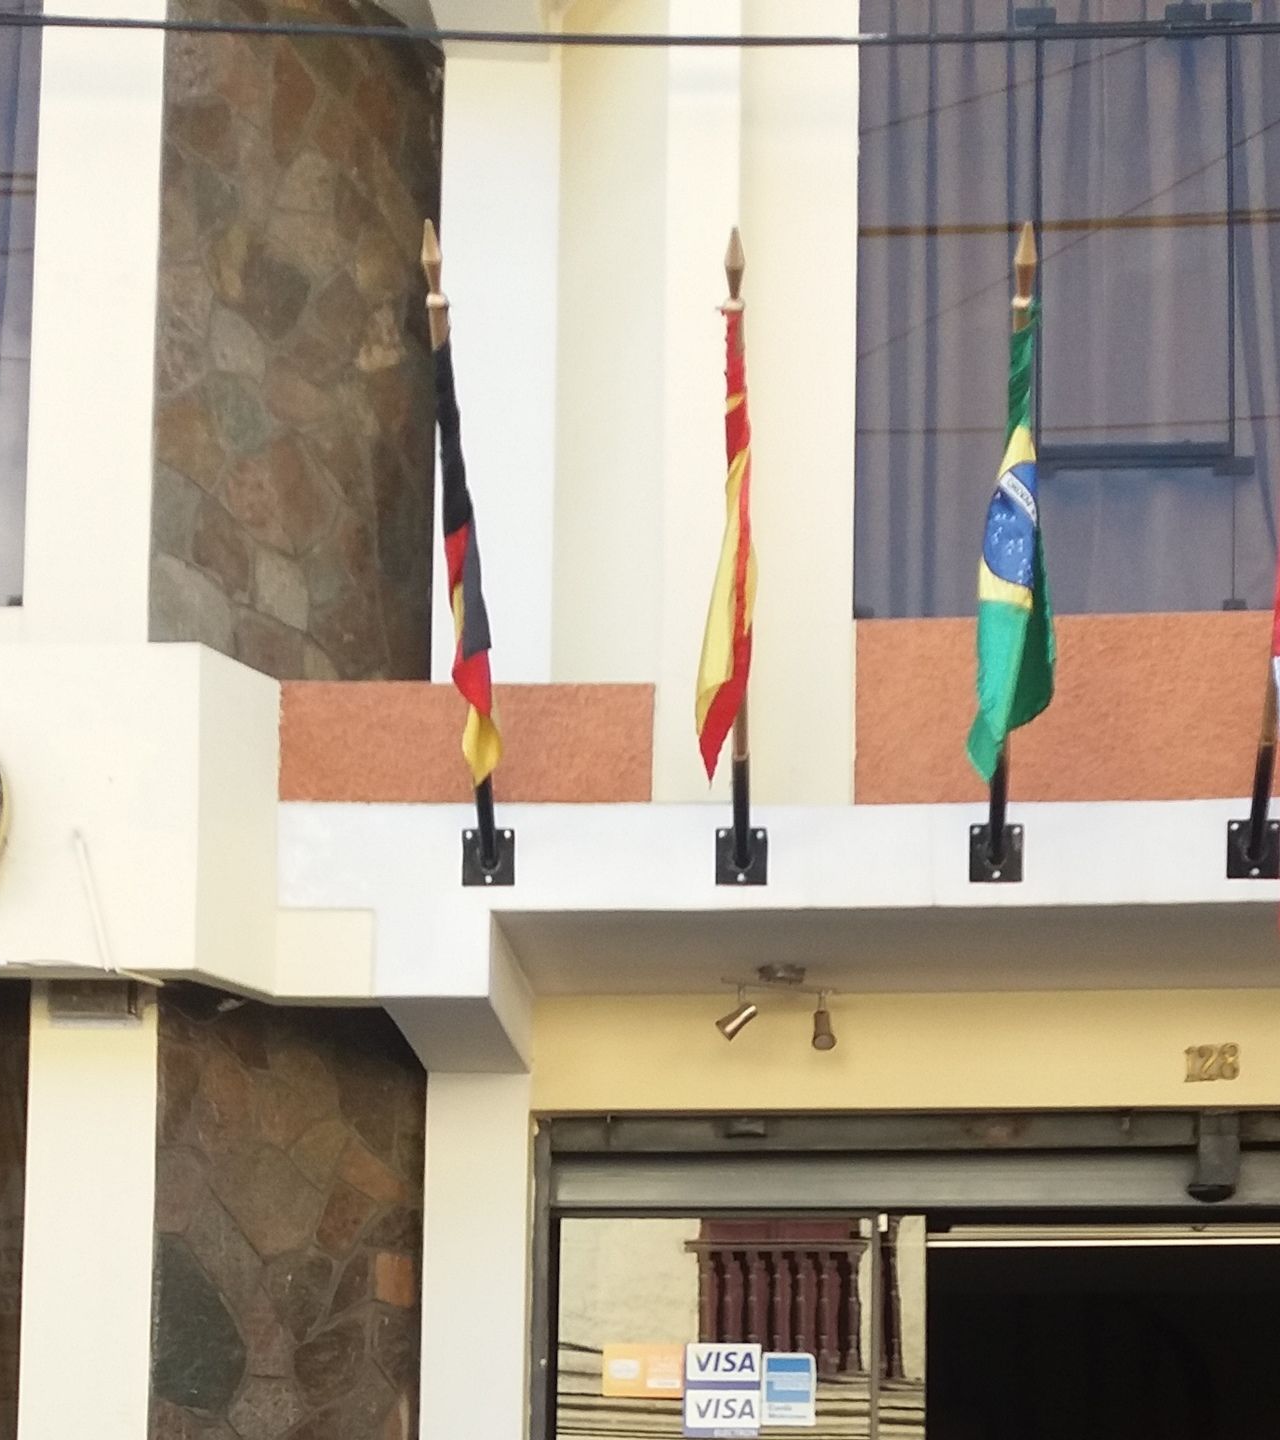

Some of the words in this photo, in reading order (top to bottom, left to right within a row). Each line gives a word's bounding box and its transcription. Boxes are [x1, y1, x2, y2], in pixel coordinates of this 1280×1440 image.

[1184, 1042, 1240, 1083] 128
[696, 1351, 755, 1373] VISA
[696, 1398, 755, 1420] VISA
